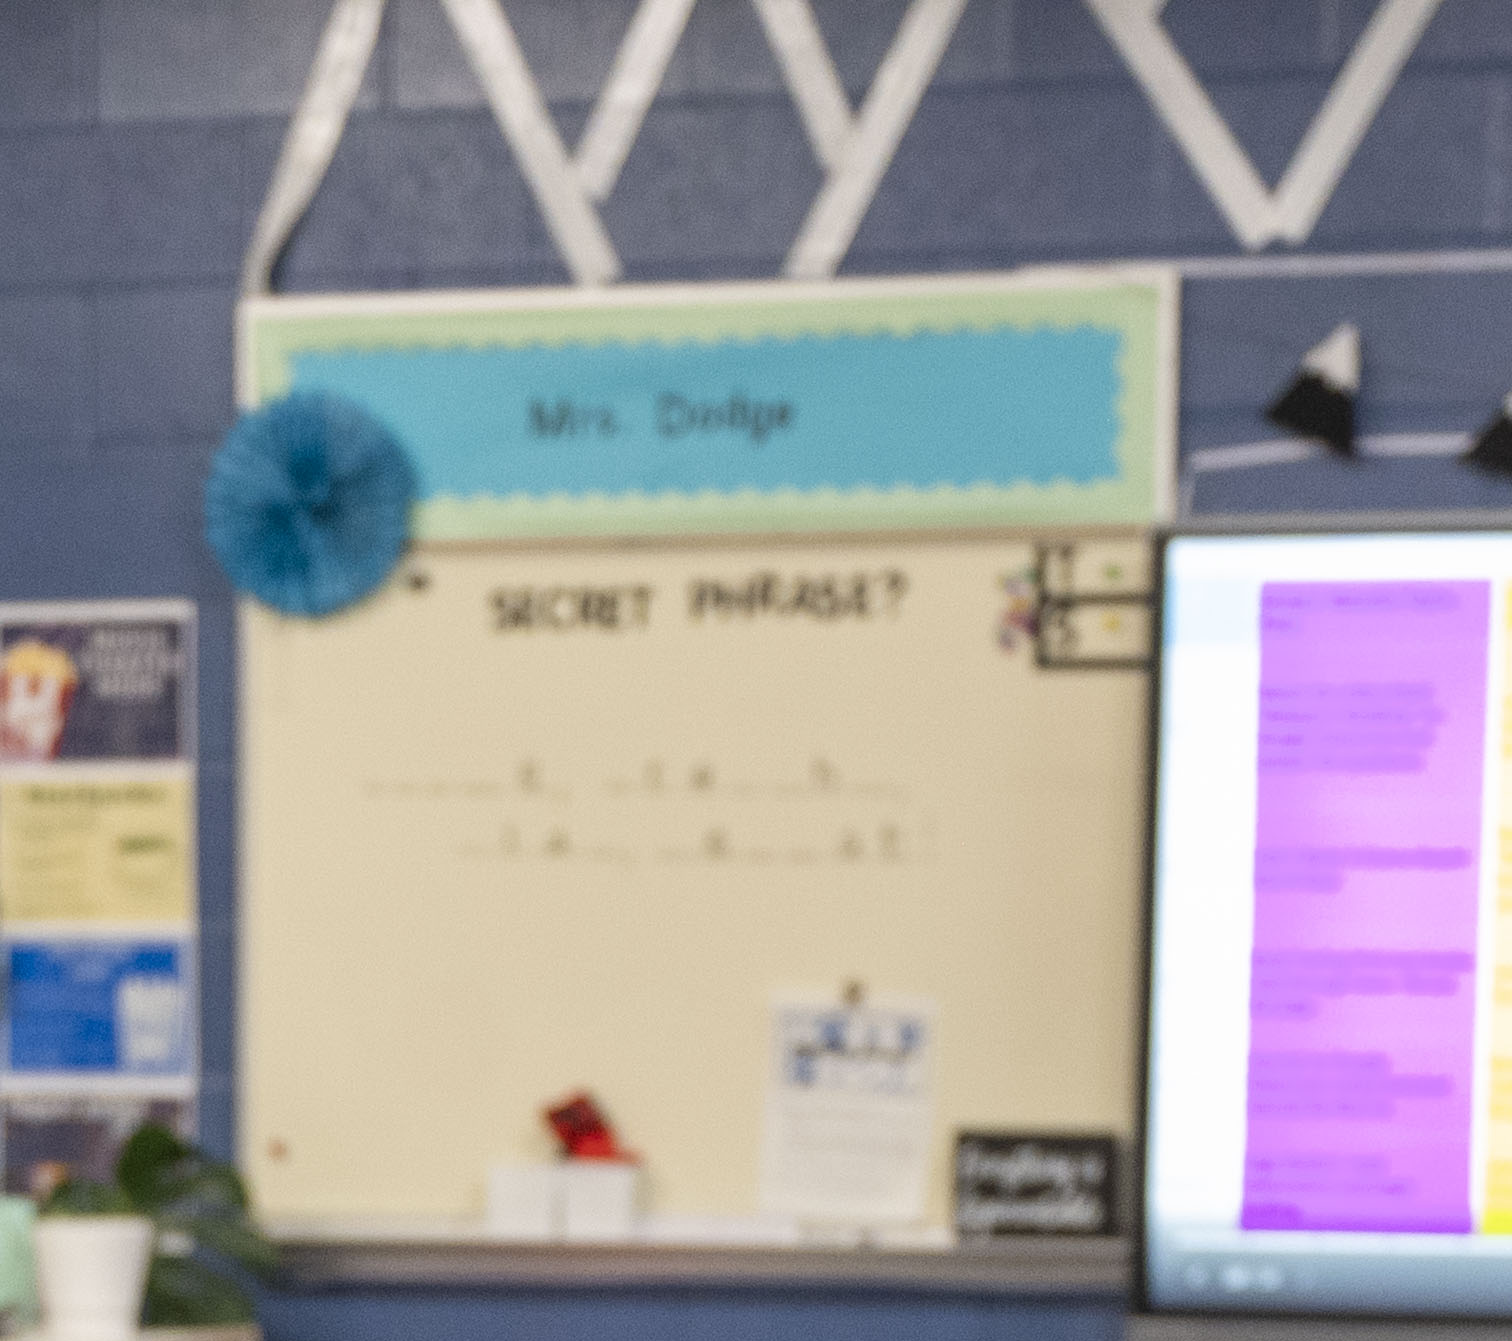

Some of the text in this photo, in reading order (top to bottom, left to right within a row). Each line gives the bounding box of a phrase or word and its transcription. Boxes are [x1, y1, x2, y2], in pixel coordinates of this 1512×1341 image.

[527, 390, 800, 445] Mrs. Dodge
[490, 571, 911, 633] SECRET PHRASE?
